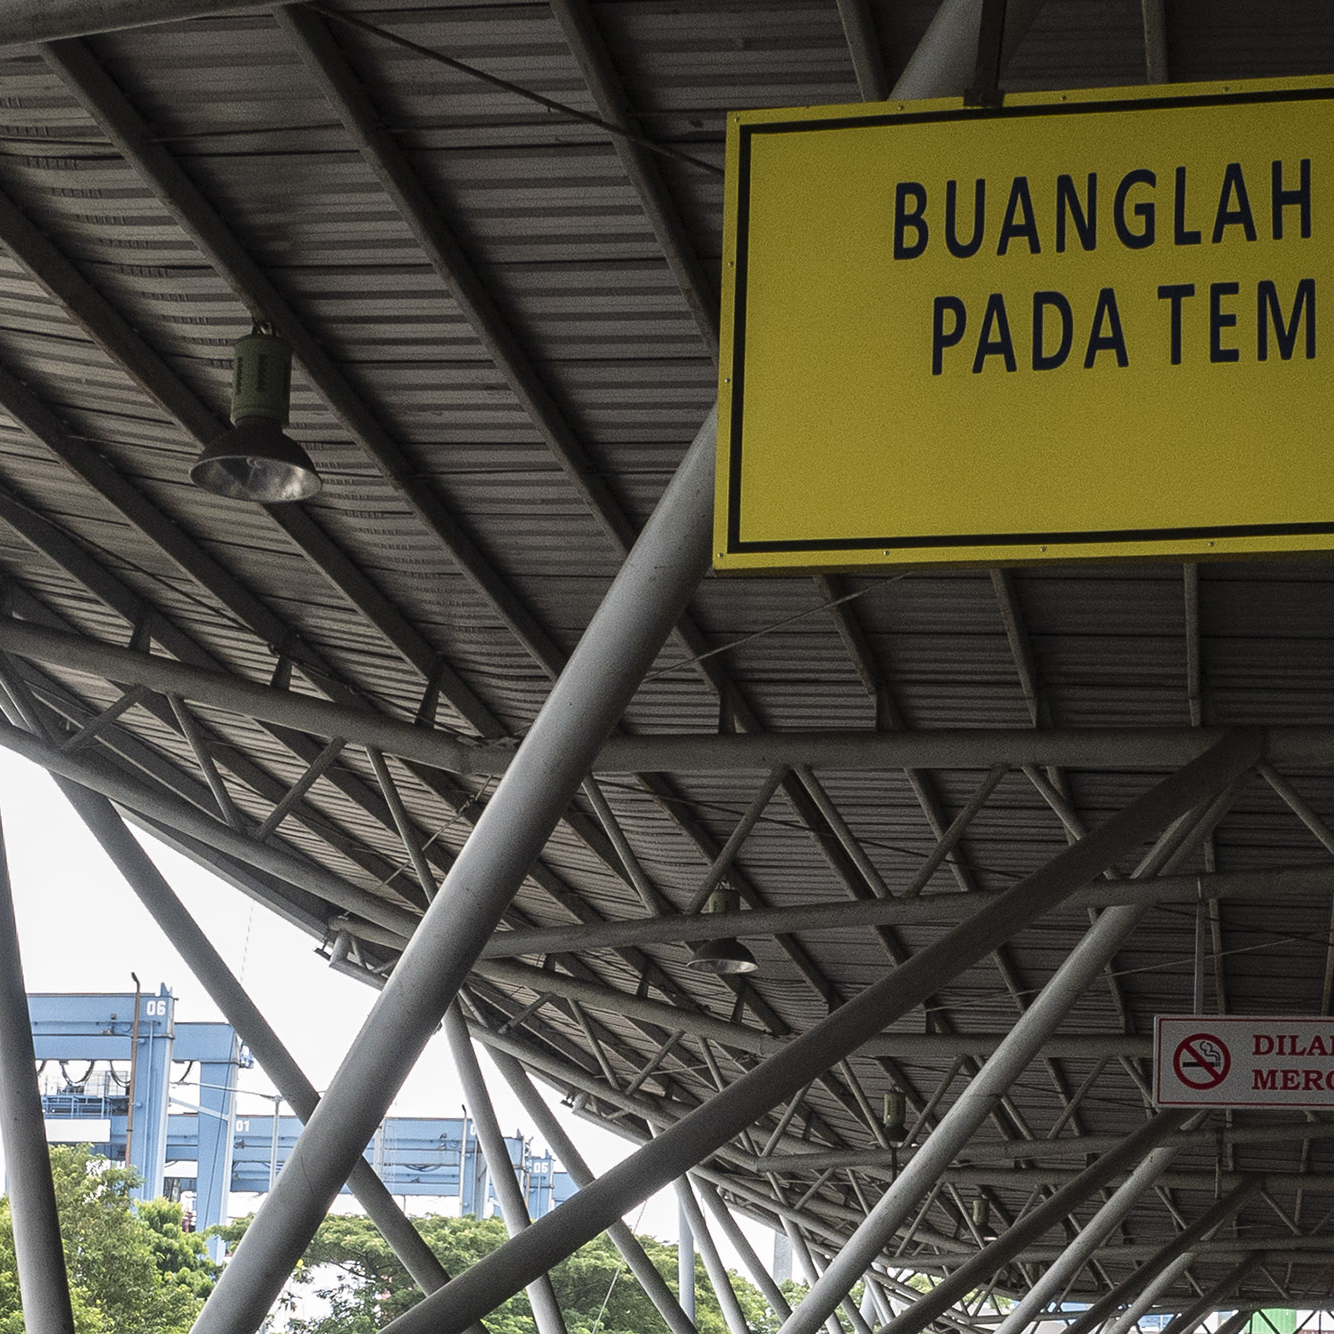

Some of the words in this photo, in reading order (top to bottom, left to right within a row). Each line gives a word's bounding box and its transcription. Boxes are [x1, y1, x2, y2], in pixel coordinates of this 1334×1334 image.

[893, 158, 1311, 260] BUANGLAH
[932, 288, 1129, 375] PADA
[146, 1000, 166, 1015] 06
[235, 1120, 250, 1132] 01
